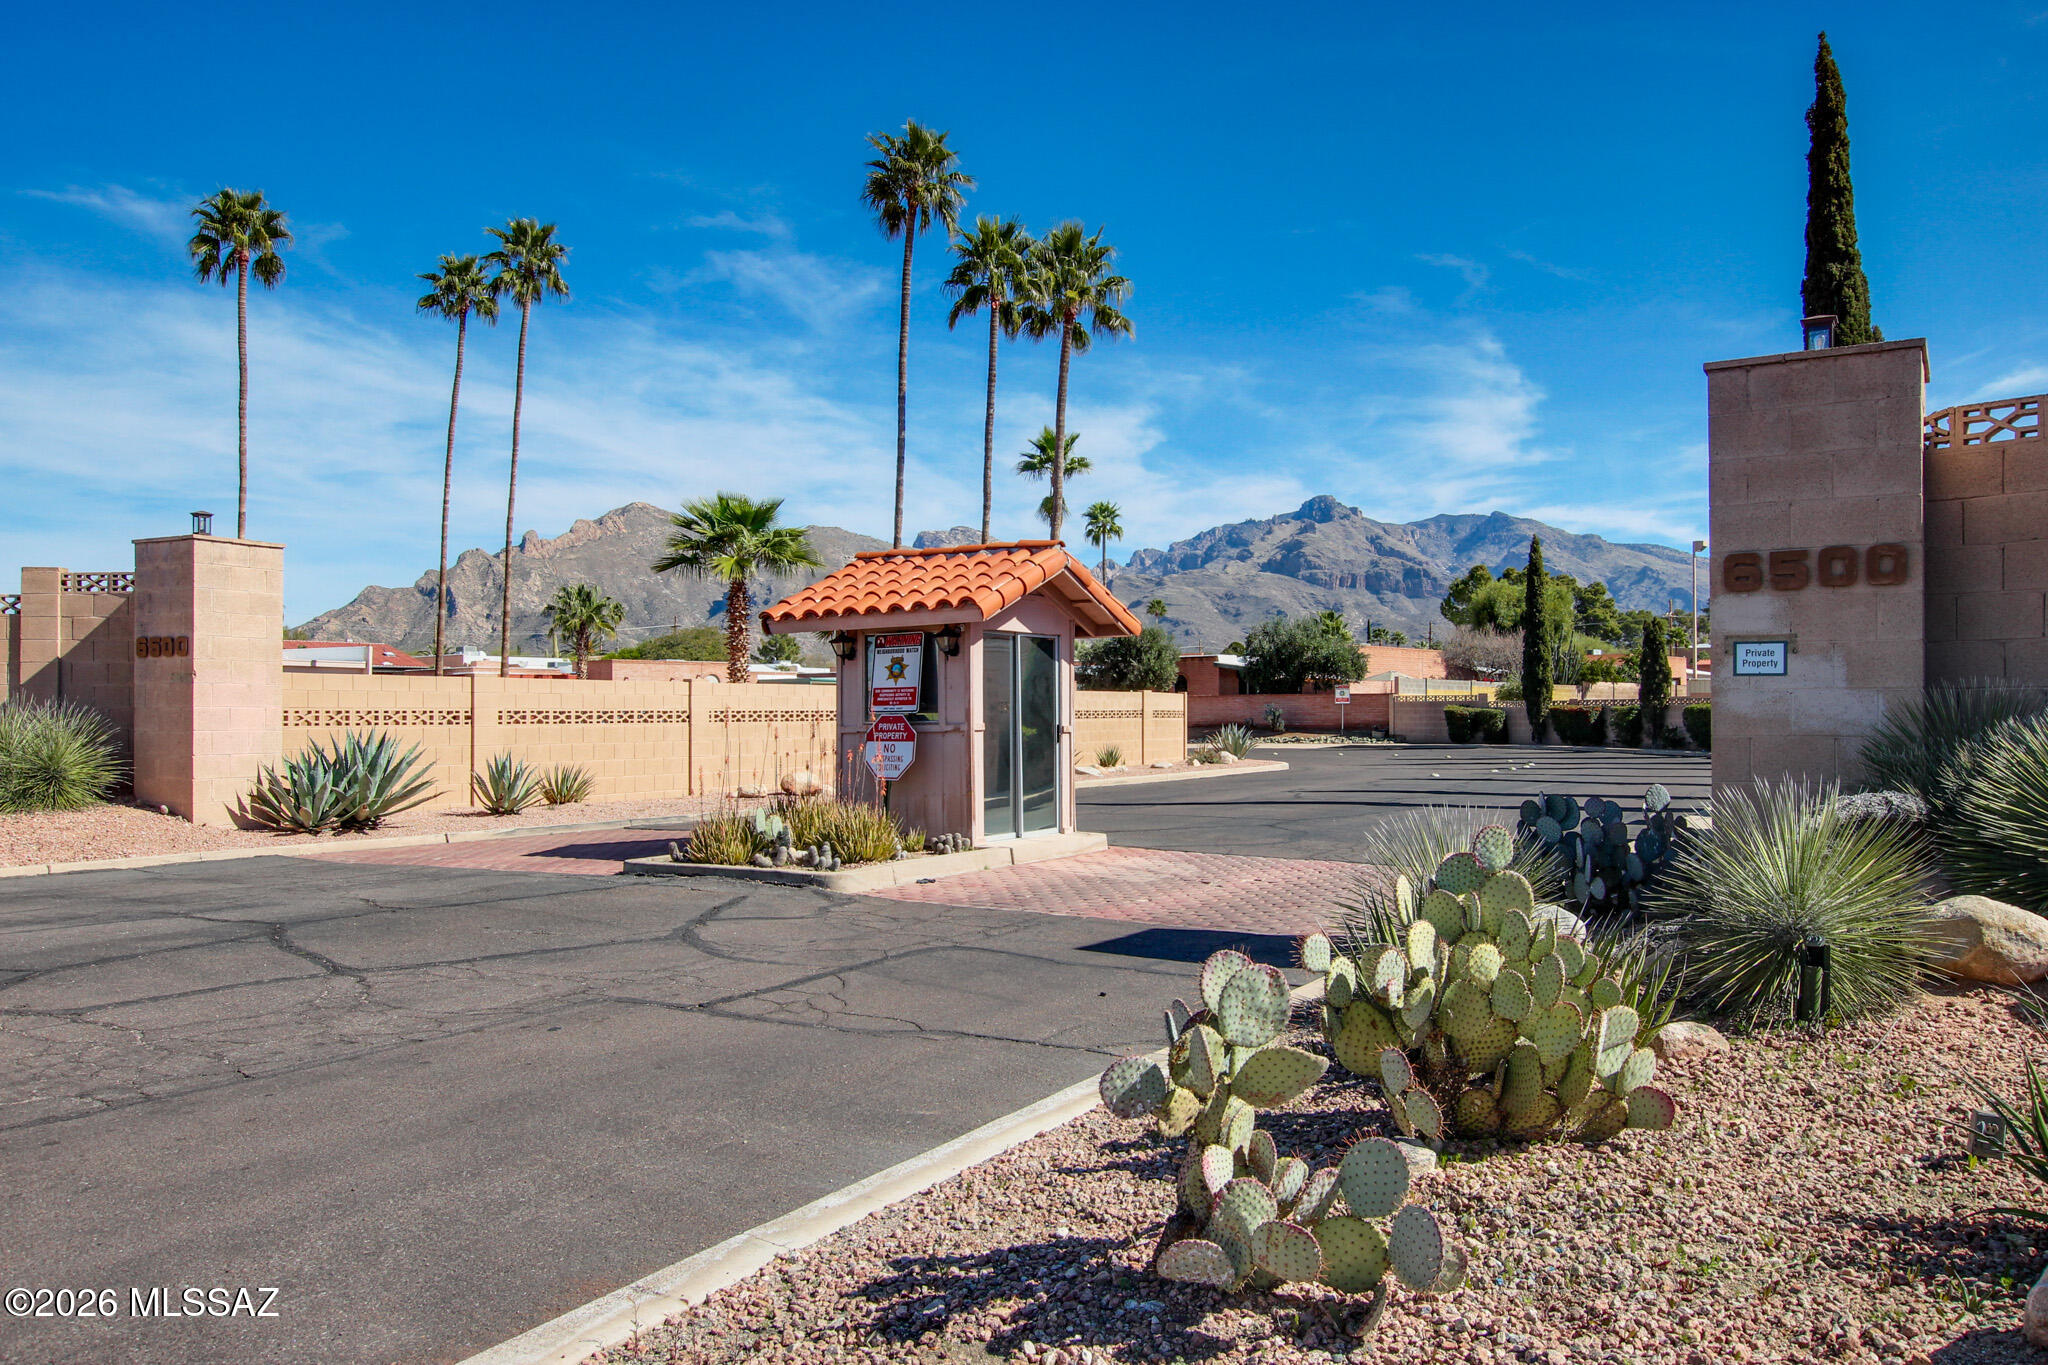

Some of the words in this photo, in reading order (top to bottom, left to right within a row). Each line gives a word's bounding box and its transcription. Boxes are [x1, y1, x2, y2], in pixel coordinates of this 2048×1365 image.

[1724, 542, 1909, 593] 6500
[884, 633, 922, 647] WARNING
[135, 635, 189, 658] 6500
[1745, 649, 1775, 657] Private
[1742, 659, 1778, 668] Property
[878, 722, 905, 731] PRIVATE
[874, 731, 908, 740] PROPERTY
[883, 743, 896, 754] NO
[874, 755, 904, 763] SPASSING
